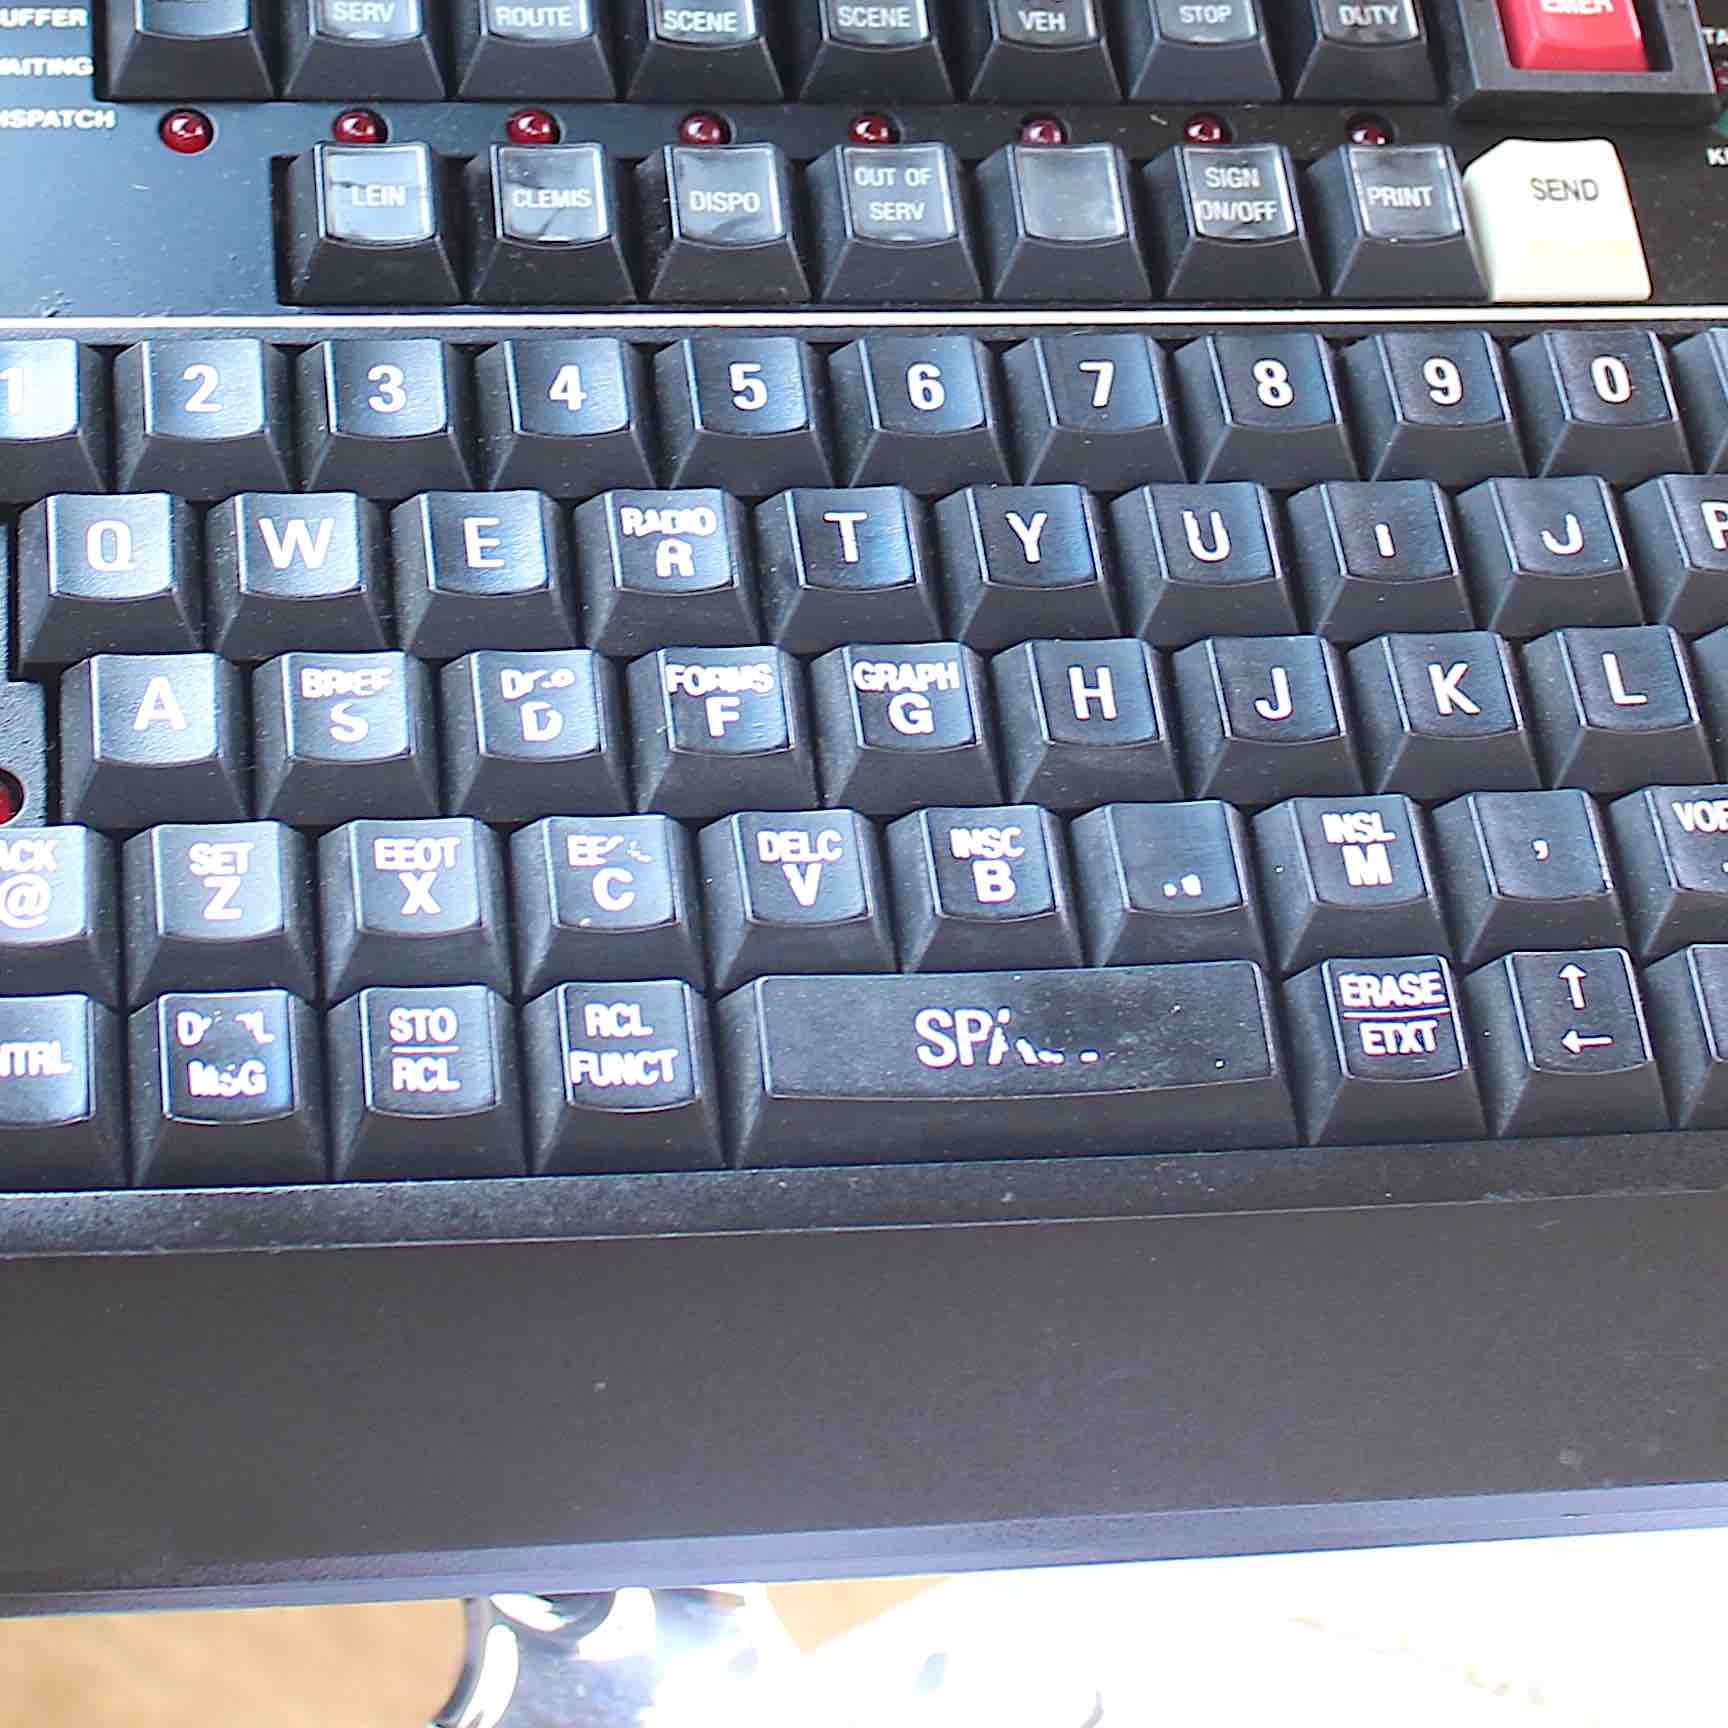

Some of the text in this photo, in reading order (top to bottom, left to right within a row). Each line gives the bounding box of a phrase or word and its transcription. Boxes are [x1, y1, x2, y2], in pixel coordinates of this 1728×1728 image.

[332, 0, 396, 24] SERV
[495, 6, 573, 28] ROUTE
[663, 9, 738, 32] SCENE
[837, 6, 913, 29] SCENE
[1019, 11, 1067, 33] VEH
[1179, 4, 1233, 26] STOP
[1339, 4, 1402, 27] DUTY
[351, 183, 407, 208] LEIN
[853, 165, 933, 189] OUT OF
[1204, 167, 1261, 190] SIGN
[1531, 176, 1601, 203] SEND
[512, 186, 593, 210] CLEMIS
[688, 189, 761, 214] DISPO
[869, 199, 928, 222] SERV
[1197, 199, 1279, 224] ON/OFF
[1367, 186, 1435, 209] PRINT
[0, 366, 25, 417] 1
[182, 362, 224, 414] 2
[367, 362, 409, 414] 3
[547, 364, 587, 412] 4
[727, 361, 770, 411] 5
[905, 361, 947, 412] 6
[1078, 359, 1115, 409] 7
[1252, 357, 1296, 409] 8
[1421, 356, 1464, 407] 9
[1589, 355, 1634, 404] 0
[620, 505, 717, 538] RADIO
[822, 511, 869, 564] T
[1004, 511, 1049, 565] Y
[1181, 509, 1232, 563] U
[84, 519, 133, 574] Q
[257, 516, 336, 570] W
[464, 516, 506, 570] E
[655, 538, 695, 578] R
[665, 662, 775, 698] FORMS
[852, 661, 961, 693] GRAPH
[1067, 665, 1119, 721] H
[1254, 666, 1294, 721] J
[1427, 661, 1481, 717] K
[1601, 651, 1649, 706] L
[132, 675, 189, 732] A
[329, 702, 369, 743] S
[705, 696, 742, 738] F
[886, 693, 936, 736] G
[756, 829, 844, 864] DELC
[948, 826, 1025, 860] INSC
[1321, 810, 1398, 845] INSL
[188, 842, 256, 876] SET
[373, 836, 462, 872] EEOT
[1341, 843, 1394, 887] M
[202, 876, 244, 921] Z
[398, 872, 442, 916] X
[590, 867, 636, 913] C
[780, 863, 824, 907] V
[971, 859, 1017, 904] B
[1337, 971, 1446, 1010] ERASE
[388, 1006, 459, 1043] STO
[583, 1003, 654, 1038] RCL
[913, 1005, 1101, 1069] SPA
[1359, 1020, 1439, 1056] ETXT
[188, 1058, 268, 1097] MSG
[392, 1057, 461, 1093] RCL
[570, 1048, 679, 1087] FUNCT
